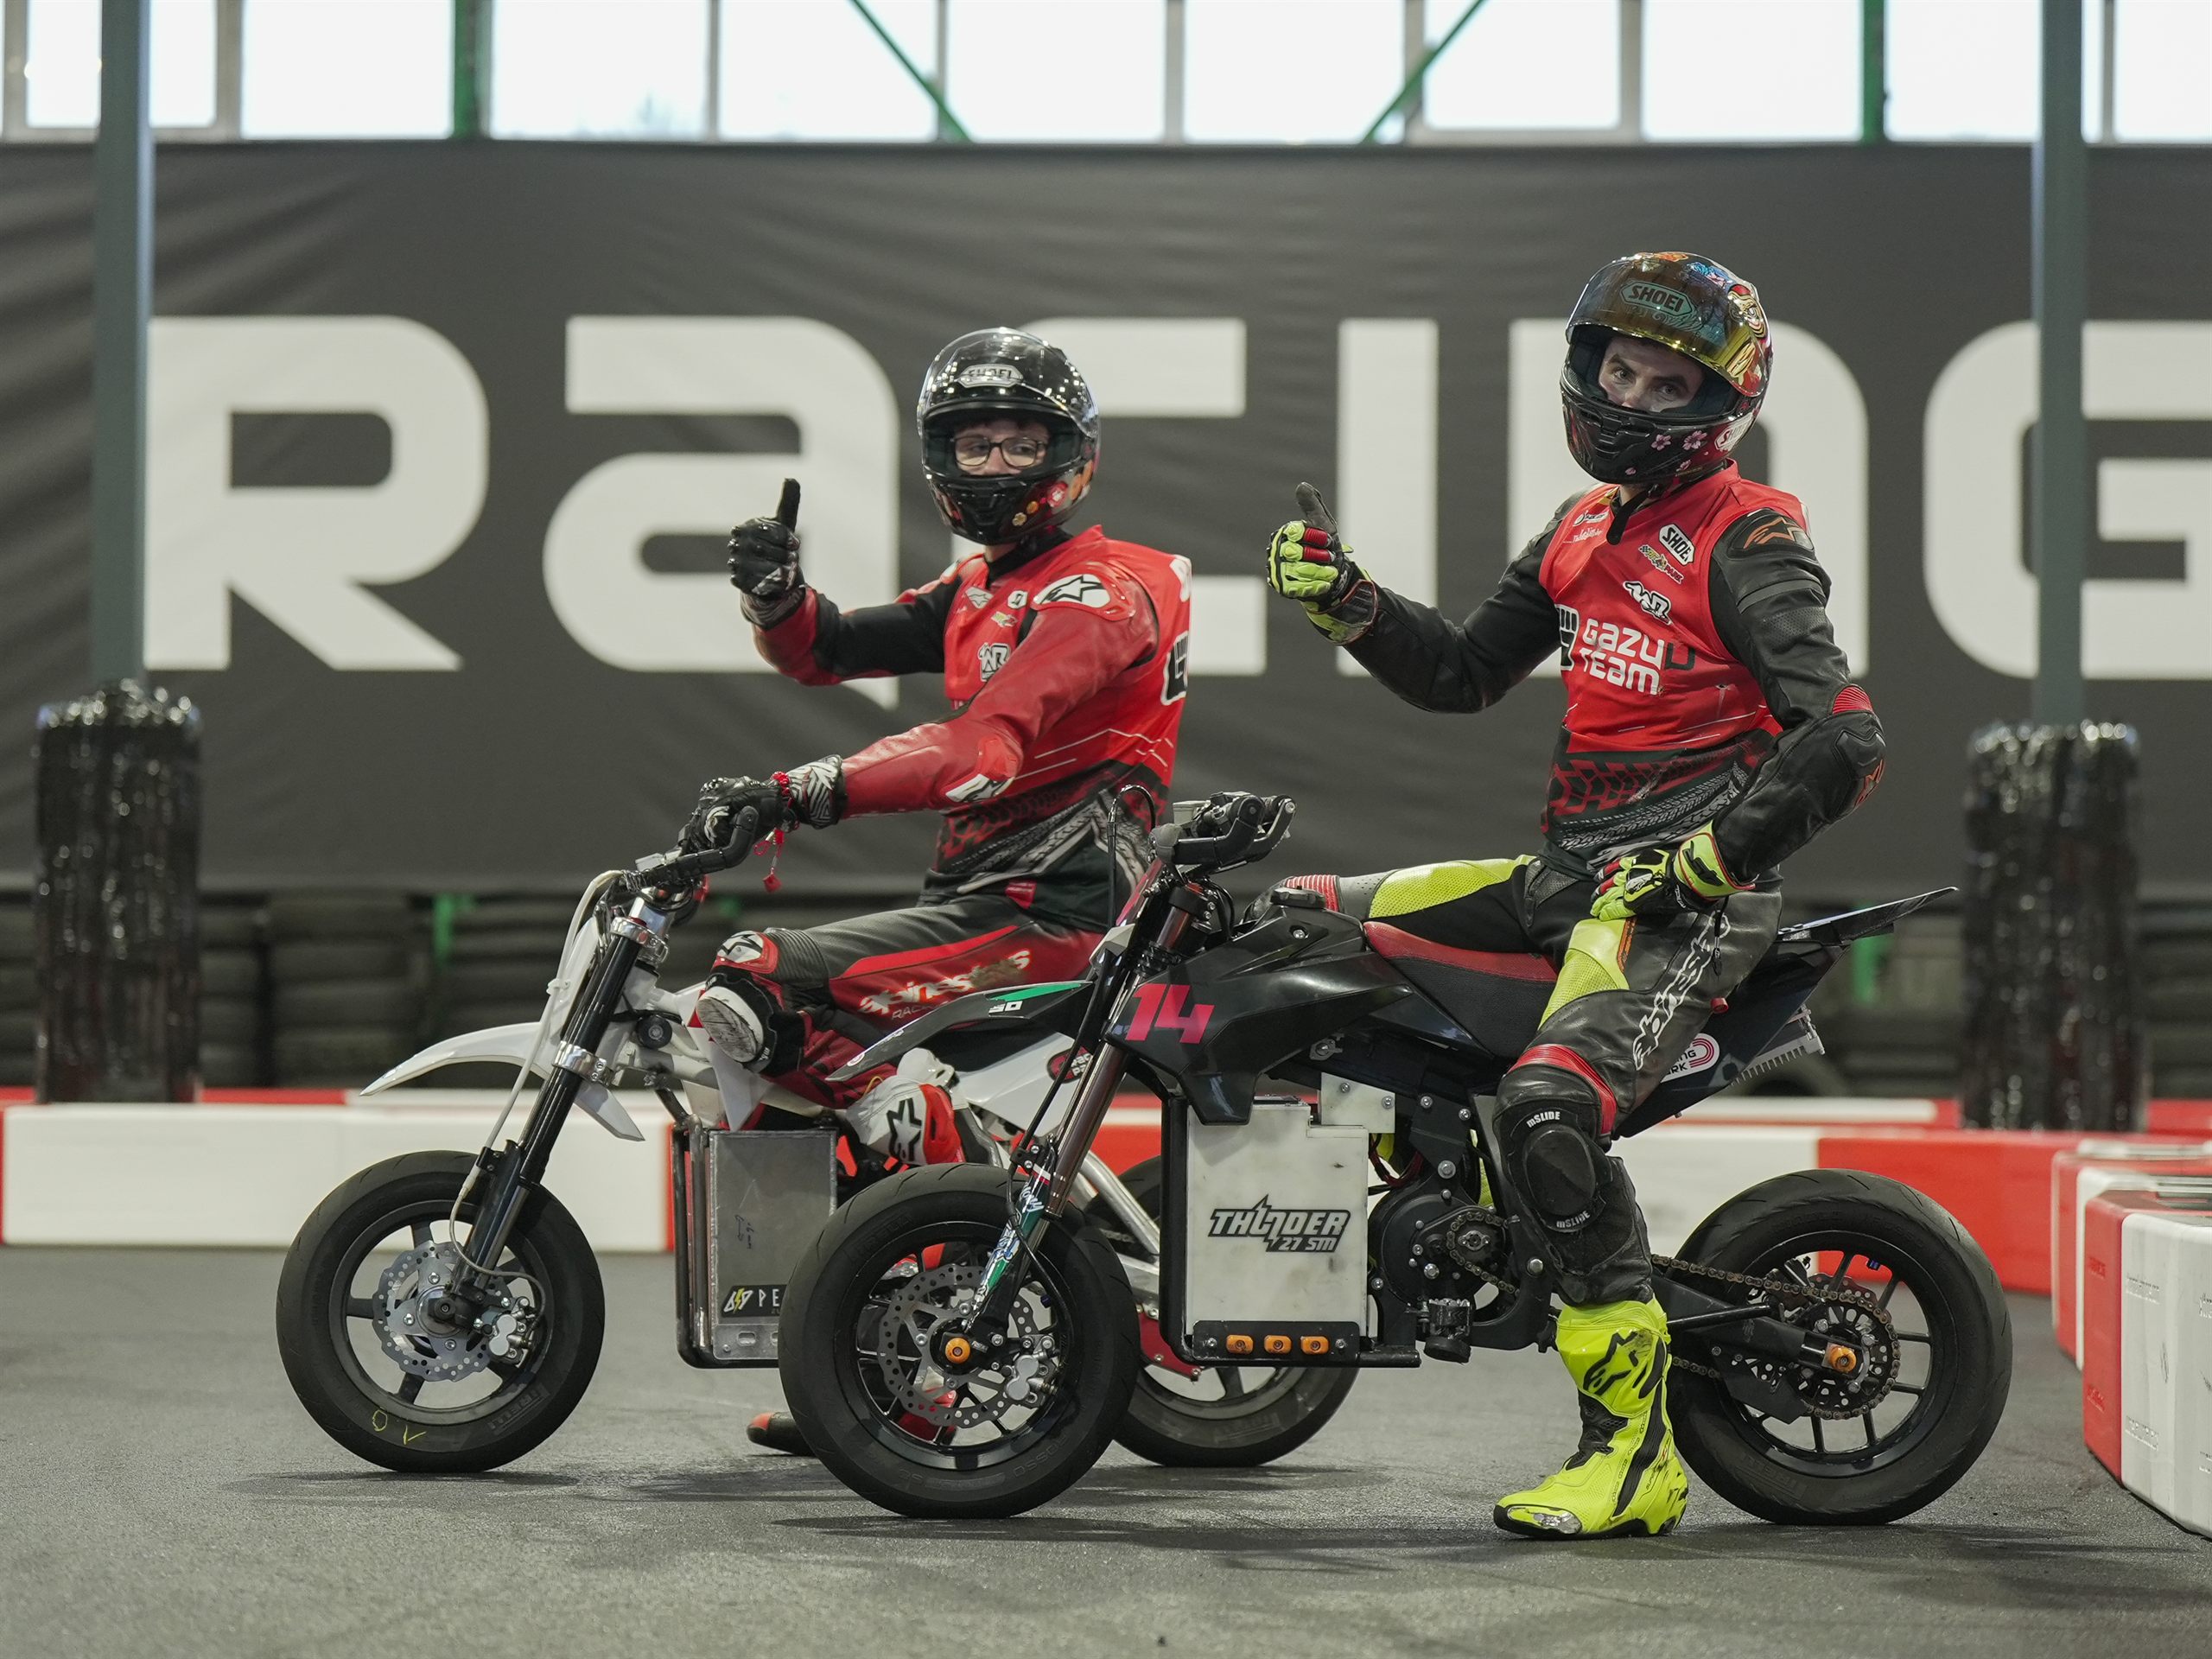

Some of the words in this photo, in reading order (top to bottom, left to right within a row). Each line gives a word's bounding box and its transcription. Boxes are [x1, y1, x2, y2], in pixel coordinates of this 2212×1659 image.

[1627, 284, 1685, 313] SHOEI
[1125, 983, 1215, 1045] 14
[1526, 1111, 1560, 1128] mSLIDE
[1211, 1198, 1344, 1241] THUNDER
[1556, 1211, 1591, 1229] mSLIDE
[1278, 1236, 1302, 1251] 27
